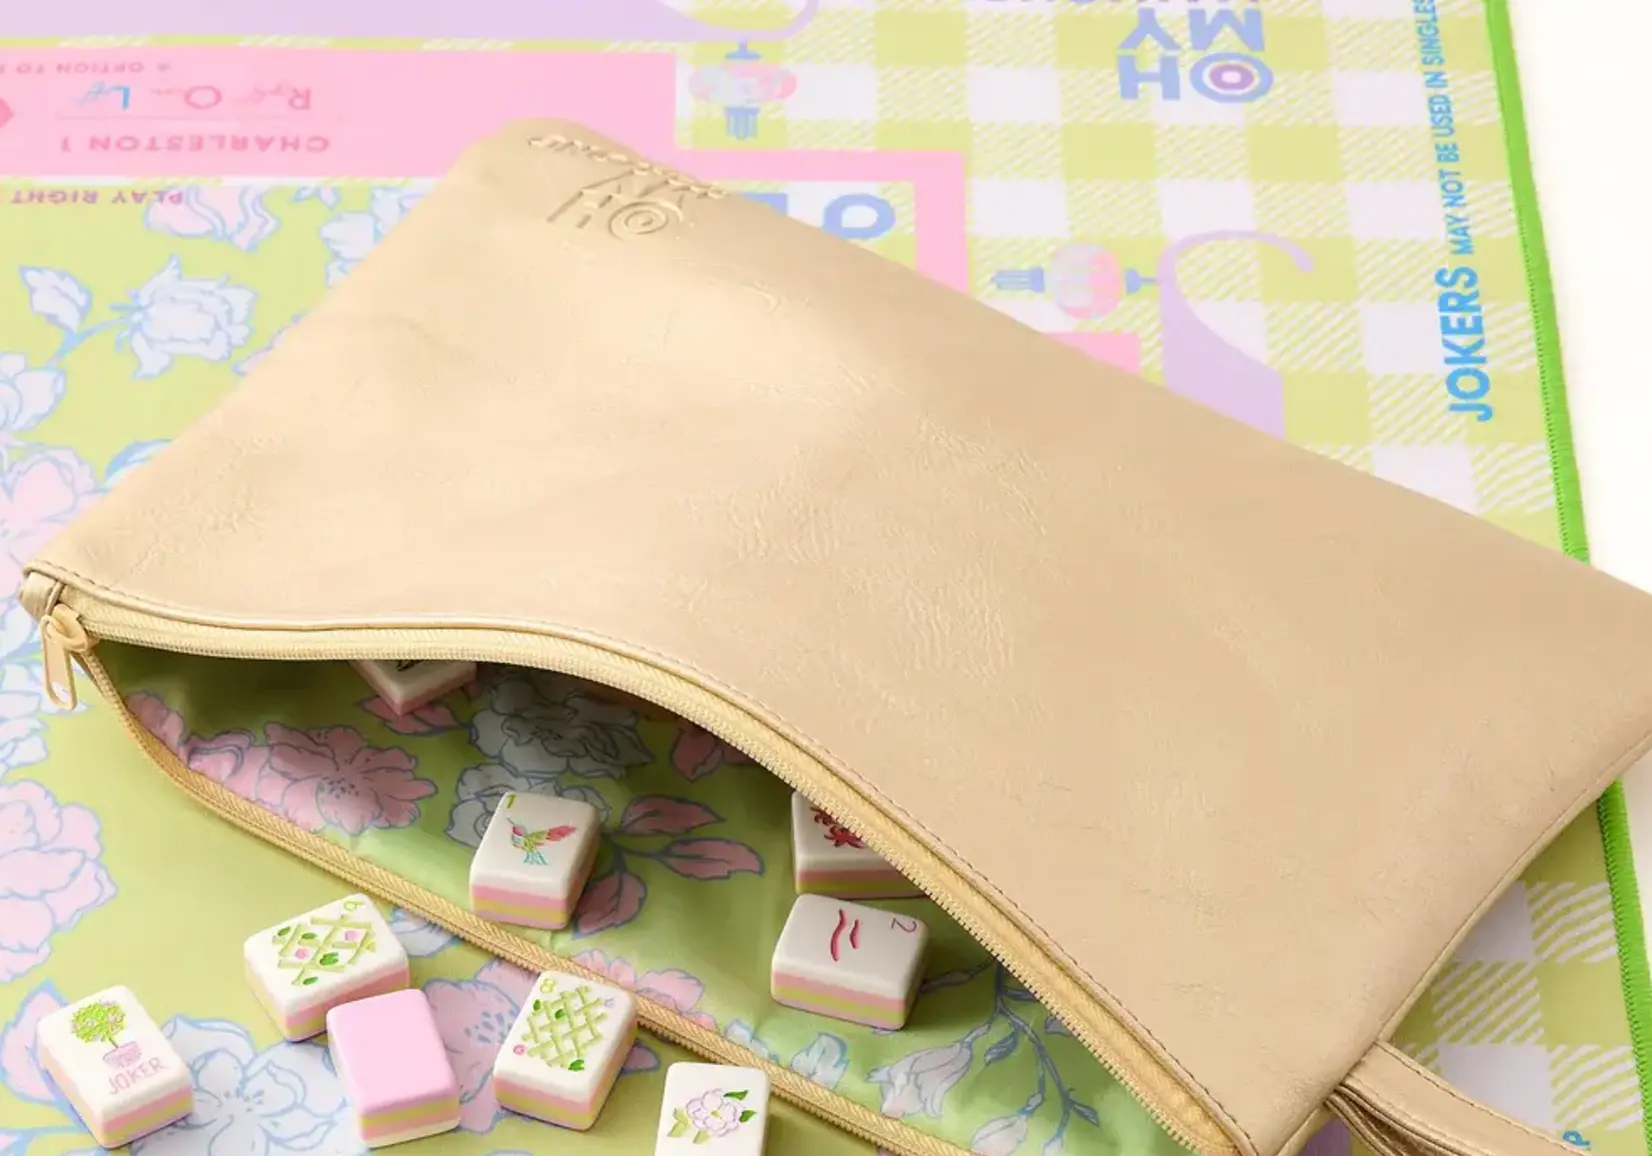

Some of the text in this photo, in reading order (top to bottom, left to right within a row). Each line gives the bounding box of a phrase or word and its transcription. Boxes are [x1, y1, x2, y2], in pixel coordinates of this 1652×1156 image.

[1116, 8, 1265, 52] MY
[56, 62, 145, 75] OPTION
[1118, 52, 1274, 104] OH
[1424, 71, 1449, 89] IN
[1428, 94, 1456, 138] USED
[61, 134, 331, 152] CHARLESTON 1
[1435, 142, 1461, 163] BE
[11, 189, 184, 205] PLAY RIGHT
[1438, 168, 1467, 209] NOT
[1445, 213, 1475, 255] MAY
[1435, 266, 1494, 422] JOKERS
[890, 916, 918, 935] 2
[107, 1056, 171, 1096] JOKER
